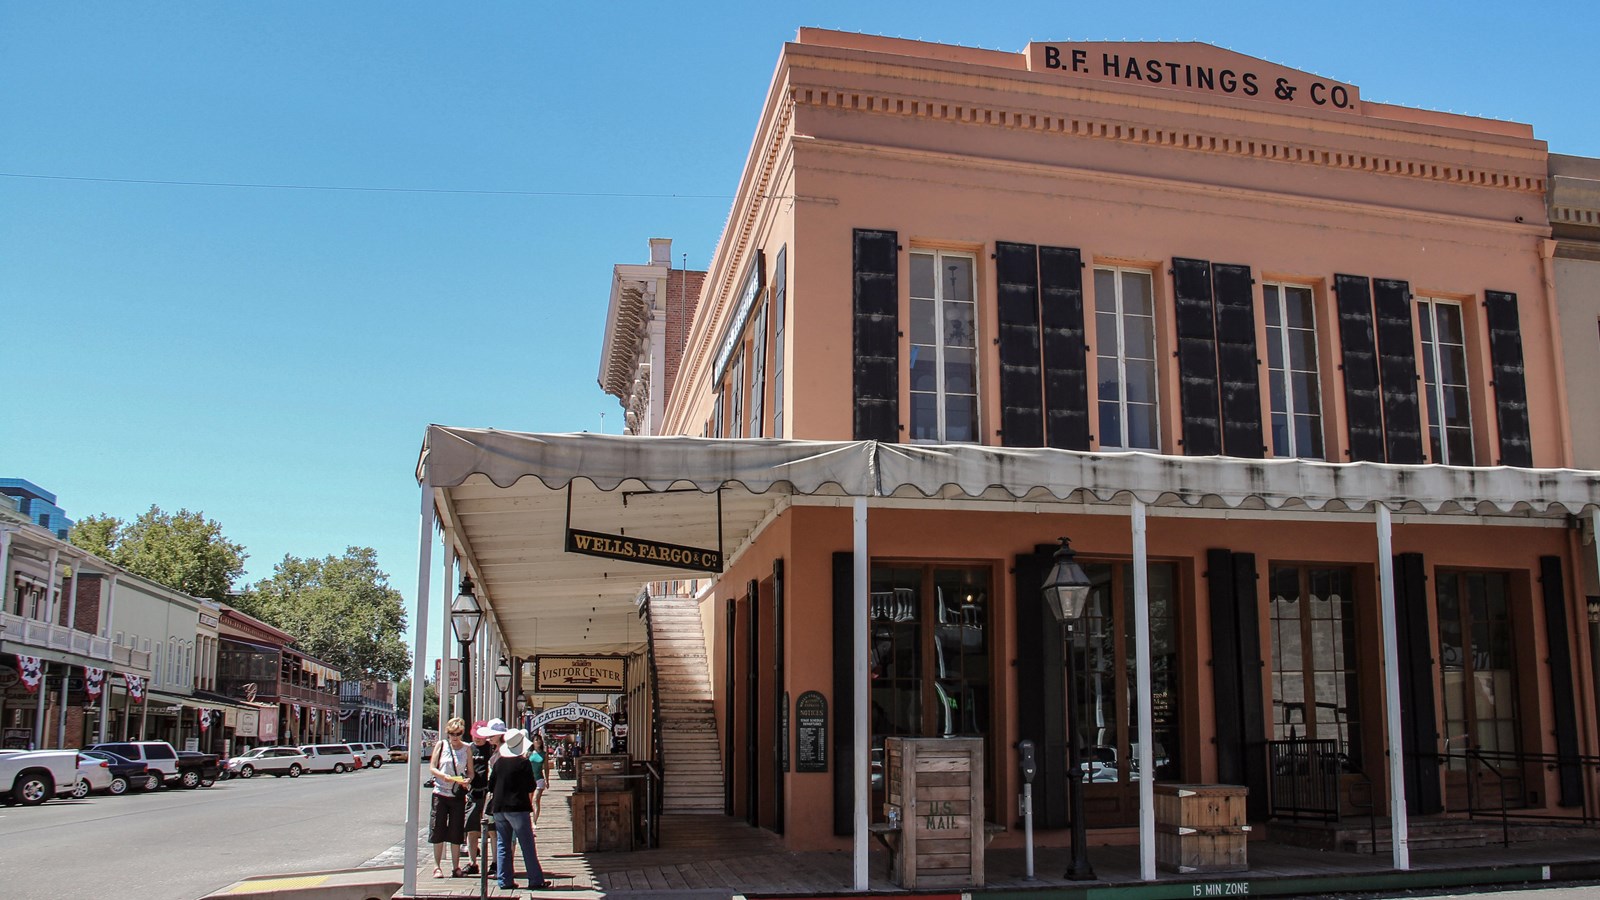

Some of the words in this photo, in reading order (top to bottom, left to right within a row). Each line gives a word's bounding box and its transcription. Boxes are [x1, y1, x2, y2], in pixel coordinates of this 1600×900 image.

[1045, 45, 1089, 74] B.F.
[1102, 53, 1259, 97] HASTINGS
[1274, 77, 1297, 101] &
[1310, 82, 1355, 110] CO.
[637, 543, 692, 565] FARGO
[542, 667, 581, 681] VISITOR
[582, 667, 621, 682] CENTER
[532, 707, 577, 728] LEATHER
[578, 708, 613, 727] WORKS
[926, 815, 959, 830] MAIL
[1192, 884, 1202, 896] 15
[1205, 884, 1222, 896] MIN
[1225, 882, 1249, 895] ZONE
